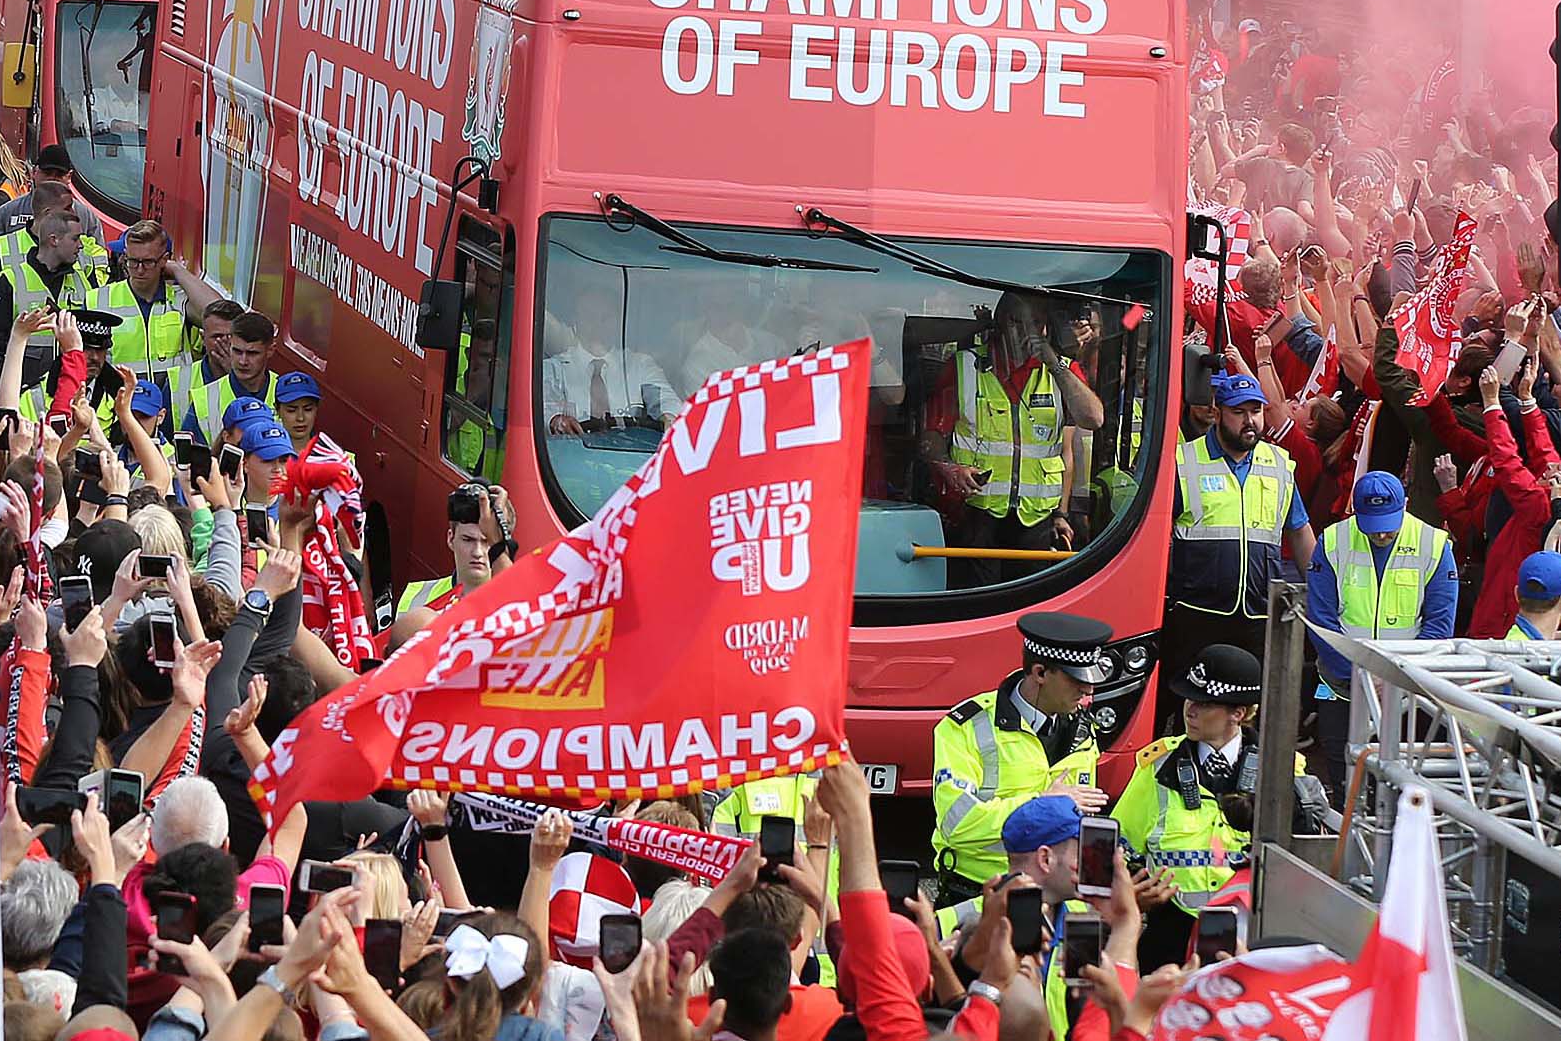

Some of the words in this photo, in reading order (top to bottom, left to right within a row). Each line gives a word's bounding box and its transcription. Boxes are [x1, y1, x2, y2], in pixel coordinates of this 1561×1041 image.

[660, 15, 762, 97] OF
[789, 23, 1089, 118] EUROPE
[296, 49, 335, 204] OF
[336, 69, 446, 276] EUROPE
[290, 223, 306, 272] WE
[304, 231, 321, 281] ARE
[355, 264, 373, 318] THIS
[371, 275, 401, 339] MEANS
[332, 603, 352, 665] OU'LL
[644, 844, 725, 879] EUROPEAN
